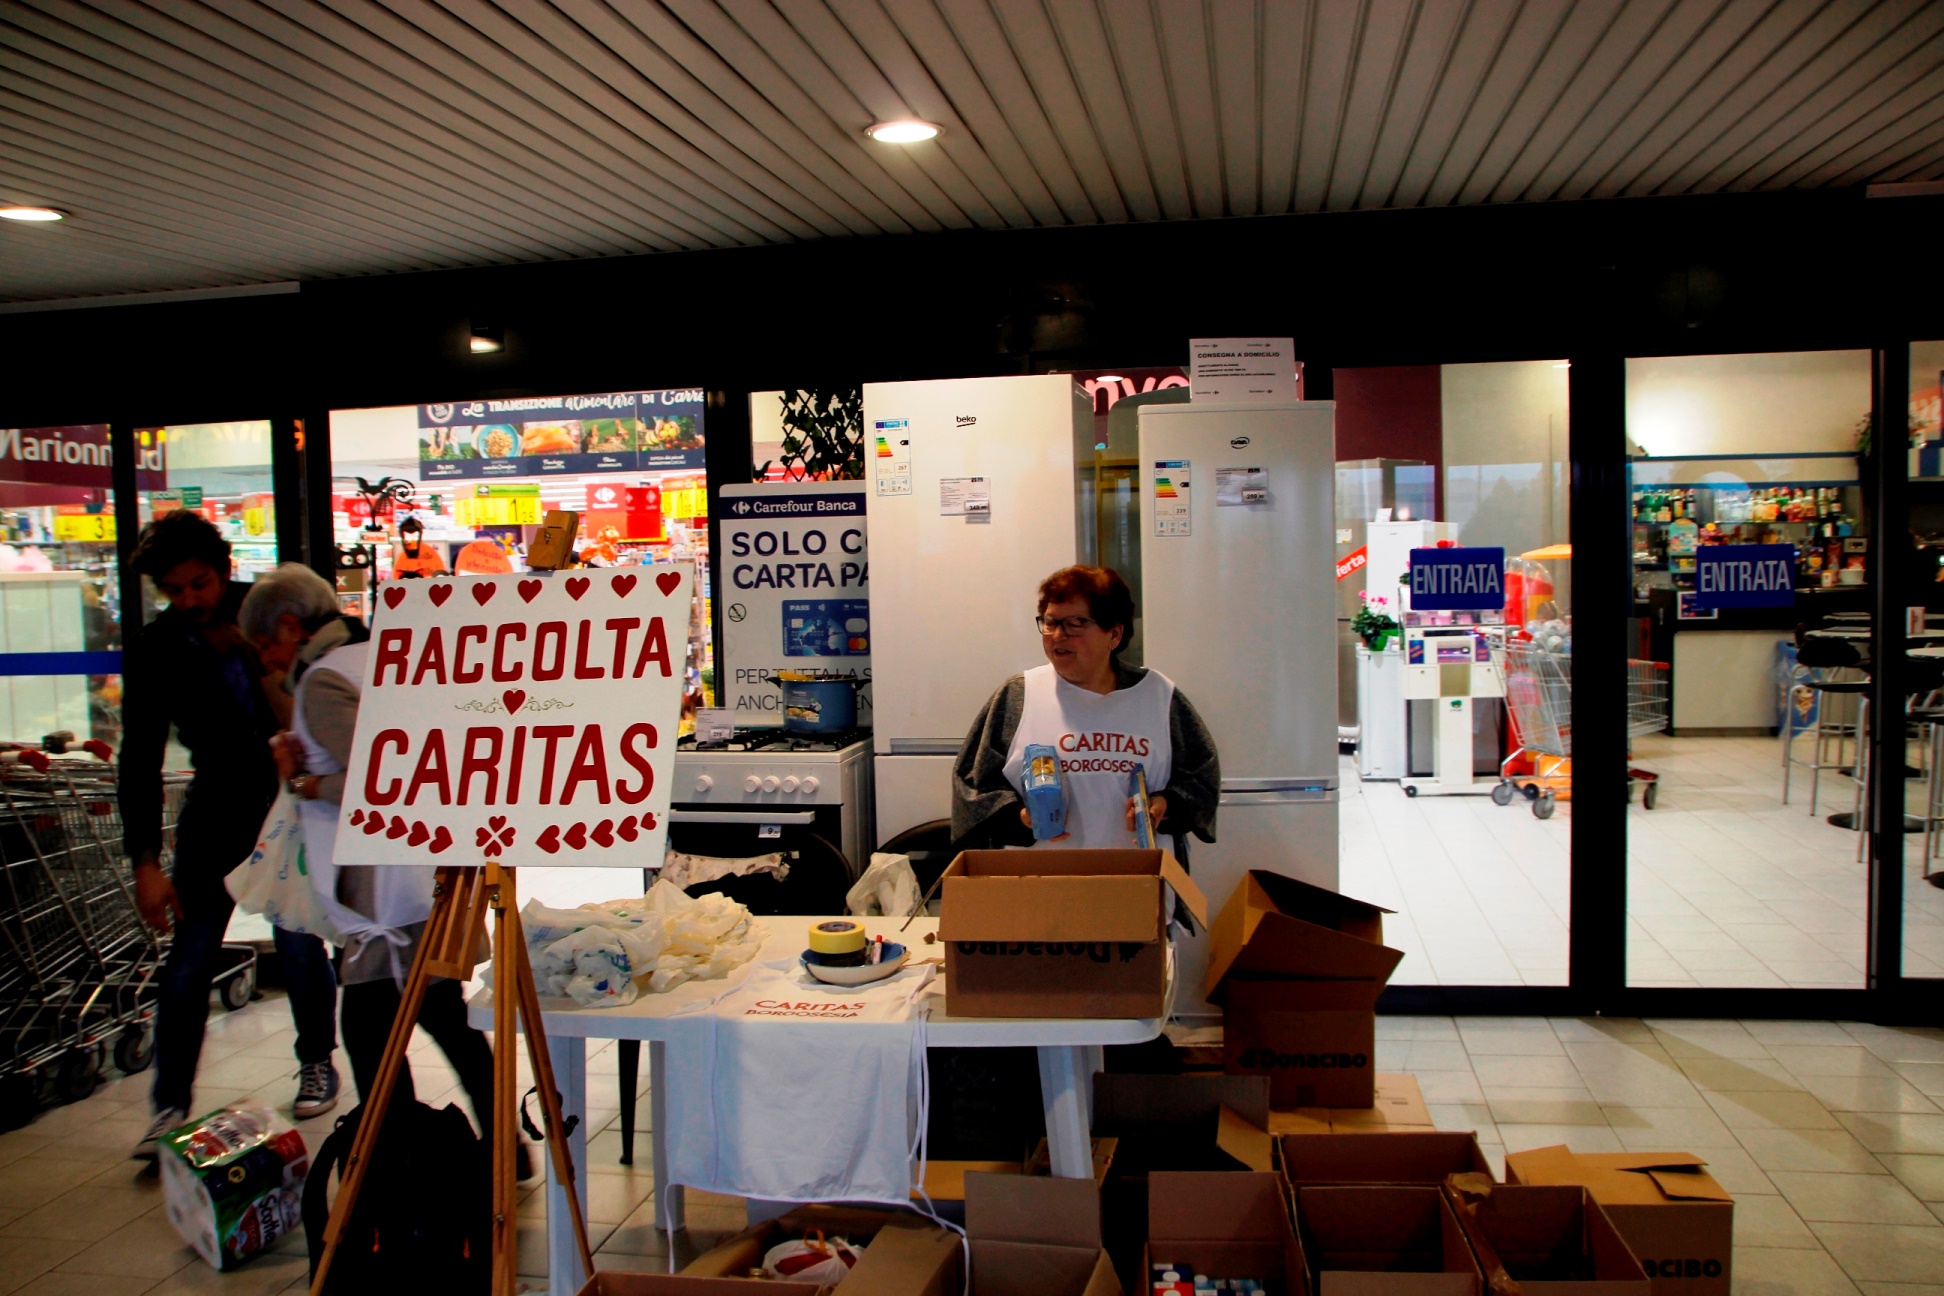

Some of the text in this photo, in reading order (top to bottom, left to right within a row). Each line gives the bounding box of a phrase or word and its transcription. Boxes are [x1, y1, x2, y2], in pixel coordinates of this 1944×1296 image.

[488, 398, 563, 413] TRANSIZIONE
[564, 393, 635, 411] alimentare
[642, 394, 655, 405] DI
[956, 415, 977, 423] beko
[0, 429, 163, 471] Marionnud
[753, 500, 857, 513] Carrefour Banca
[732, 529, 868, 557] SOLO C
[733, 562, 836, 590] CARTA
[1412, 563, 1500, 595] ENTRATA
[1700, 559, 1791, 592] ENTRATA
[372, 616, 673, 687] RACCOLTA
[736, 669, 769, 684] PER
[1059, 732, 1150, 757] CARITAS
[364, 722, 658, 806] CARITAS
[1061, 758, 1138, 774] BORGOSES
[744, 1009, 859, 1018] BORGOSESIA
[755, 1000, 867, 1011] CARITAS
